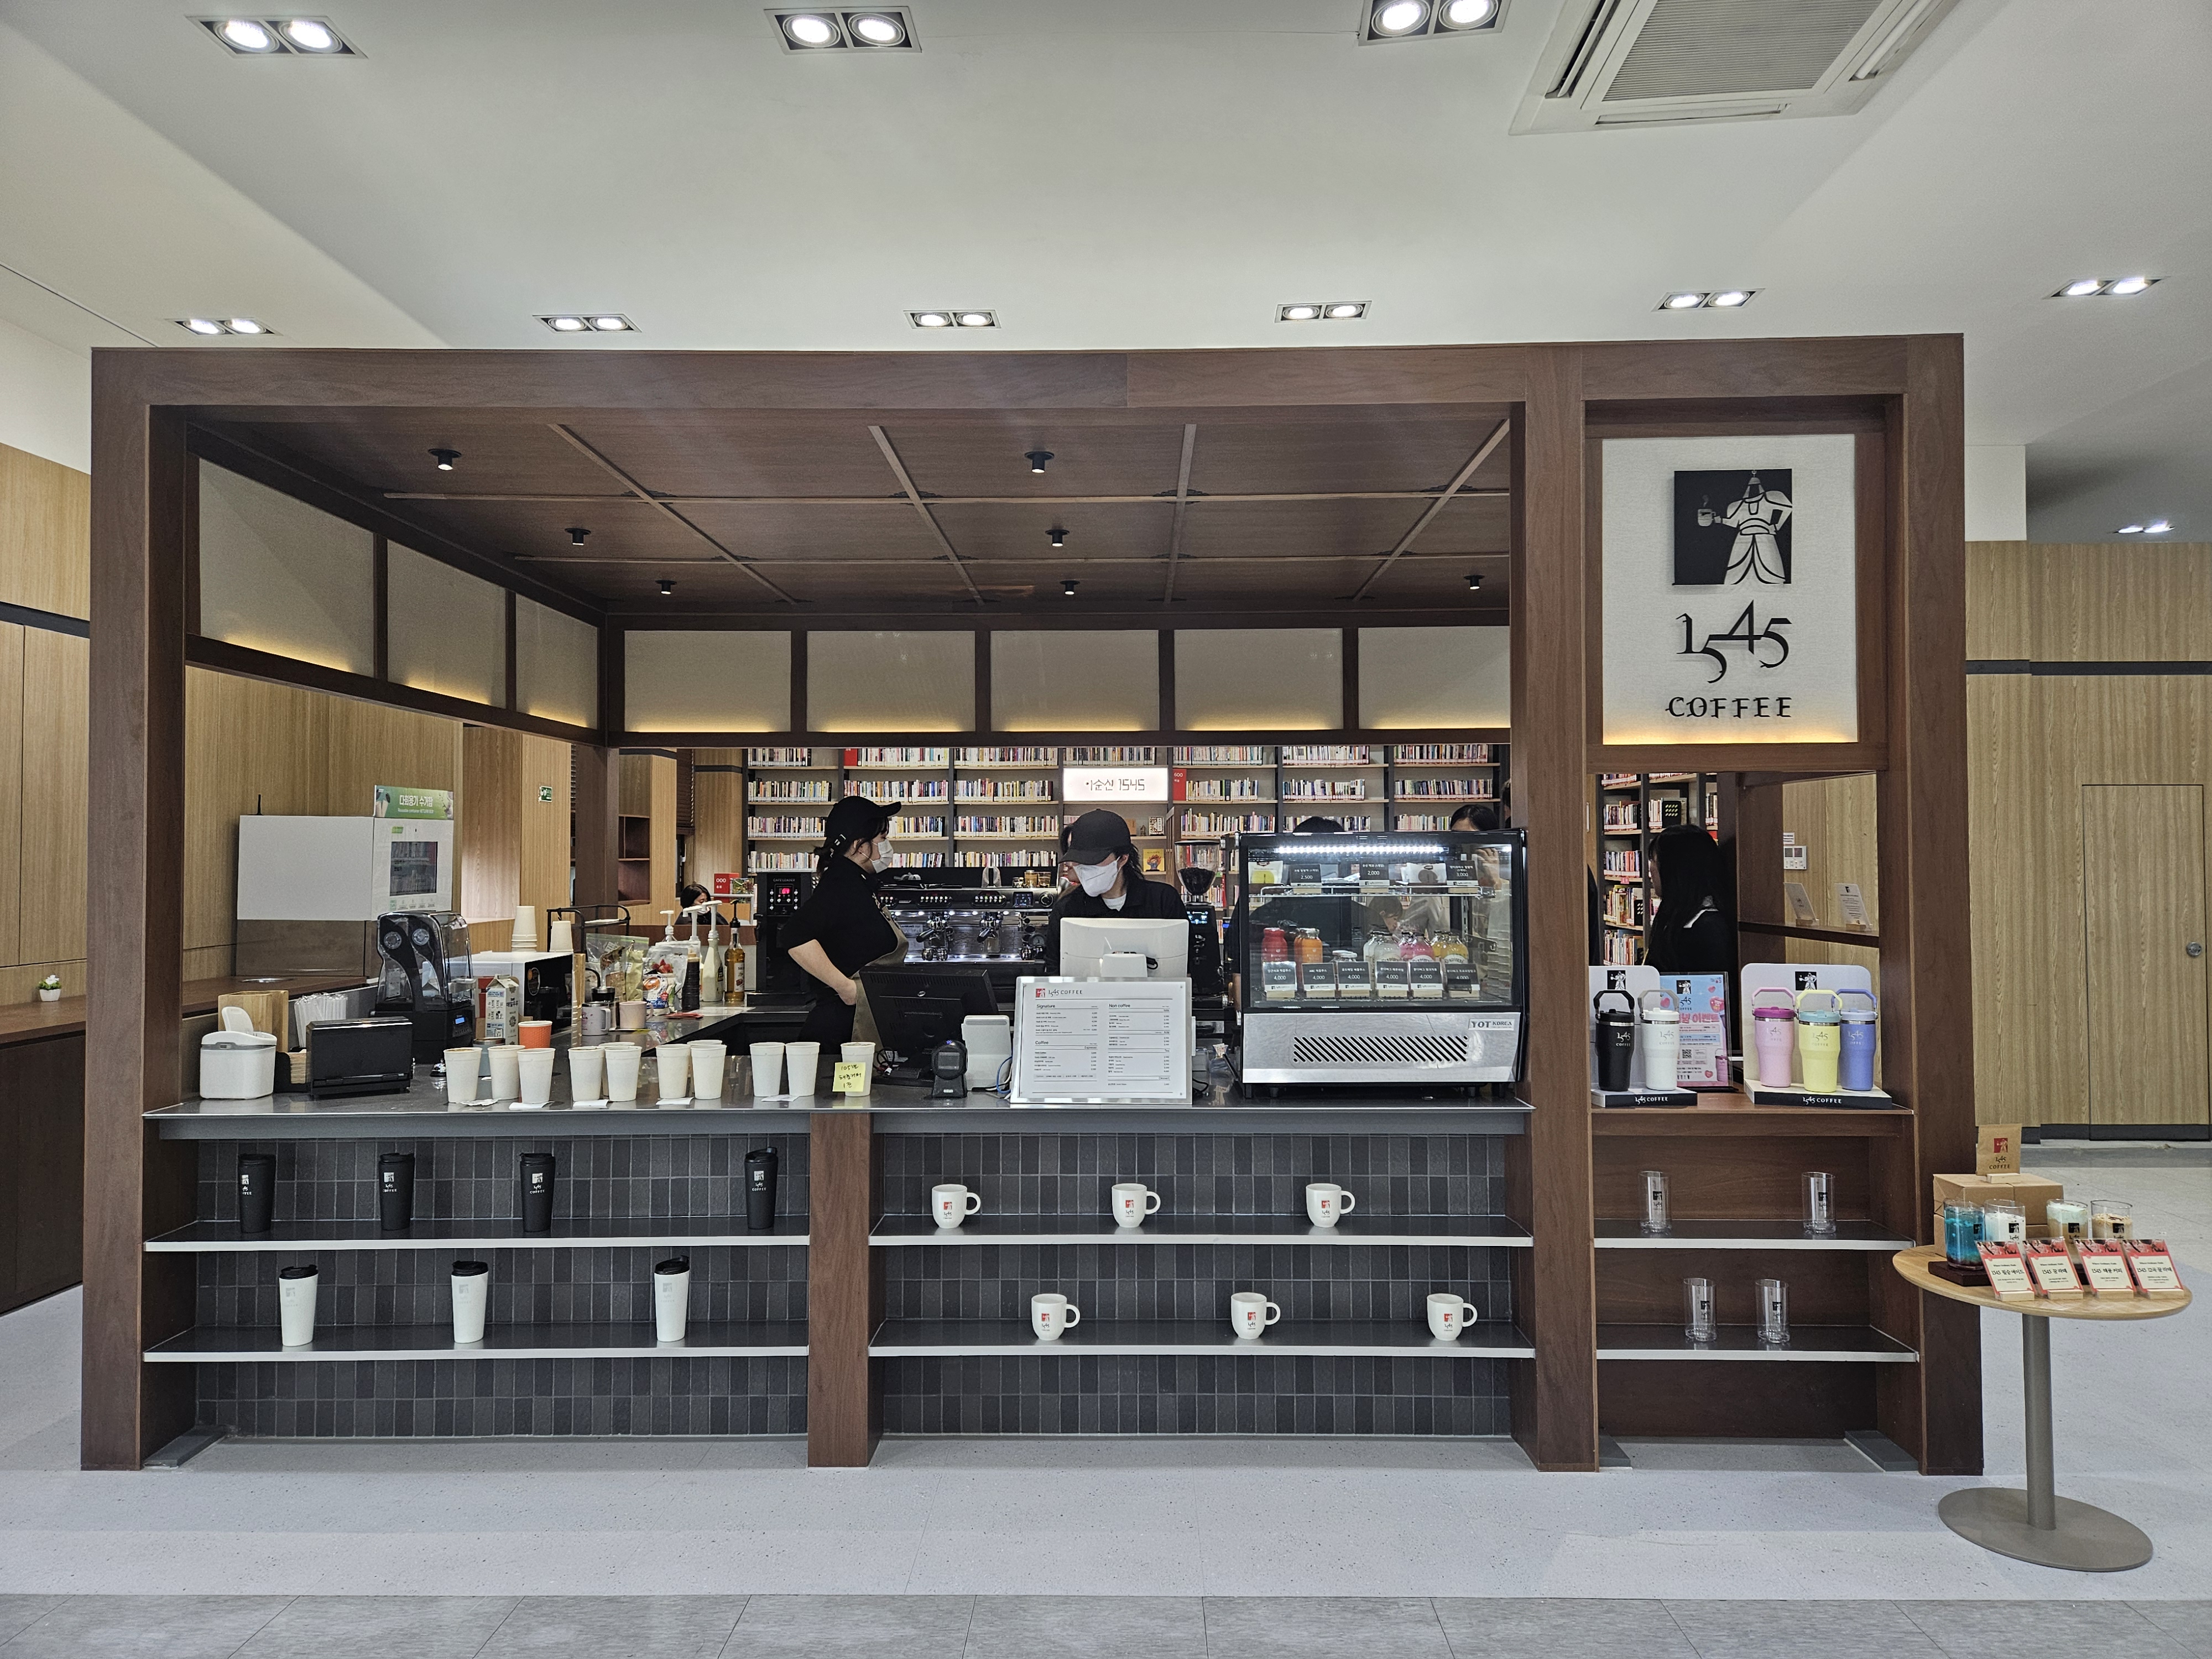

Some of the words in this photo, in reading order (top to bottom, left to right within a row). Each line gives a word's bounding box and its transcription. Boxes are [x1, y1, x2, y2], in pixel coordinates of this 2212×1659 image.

[1676, 599, 1792, 684] 1545
[1665, 696, 1792, 718] COFFEE
[1086, 779, 1113, 791] 이순신
[1118, 779, 1145, 791] 1545
[399, 794, 418, 806] 다회용기
[419, 796, 433, 807] 수거함
[1048, 989, 1060, 997] 1545
[1679, 996, 1692, 1007] 545
[1692, 1013, 1719, 1023] 이벤트
[1616, 1031, 1631, 1042] 1545
[1660, 1030, 1674, 1041] 1545
[1812, 1031, 1828, 1042] 1545
[1848, 1030, 1864, 1041] 1545
[1635, 1095, 1646, 1105] 1545
[1802, 1096, 1815, 1105] 1545
[1995, 1156, 2006, 1164] 1545
